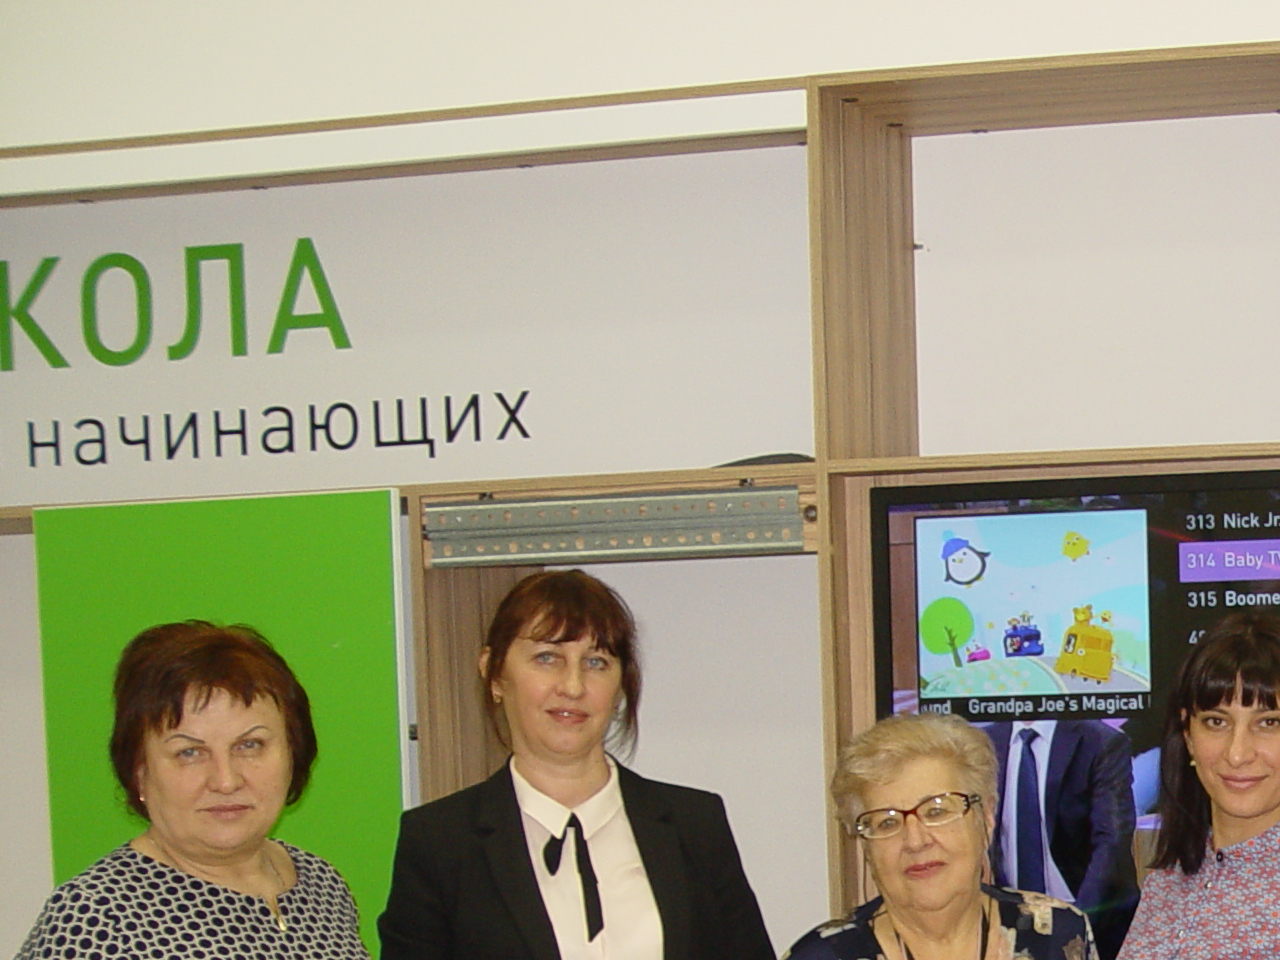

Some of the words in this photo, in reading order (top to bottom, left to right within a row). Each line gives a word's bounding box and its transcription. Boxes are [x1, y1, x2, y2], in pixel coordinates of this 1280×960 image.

[28, 390, 531, 468] начинающих
[1186, 514, 1216, 531] 313
[1223, 512, 1260, 529] Nick
[1187, 553, 1216, 569] 314
[1224, 551, 1264, 570] Baby
[1187, 591, 1218, 608] 315
[968, 698, 1034, 716] Grandpa
[1037, 696, 1079, 713] Joe's
[1082, 694, 1144, 714] Magical
